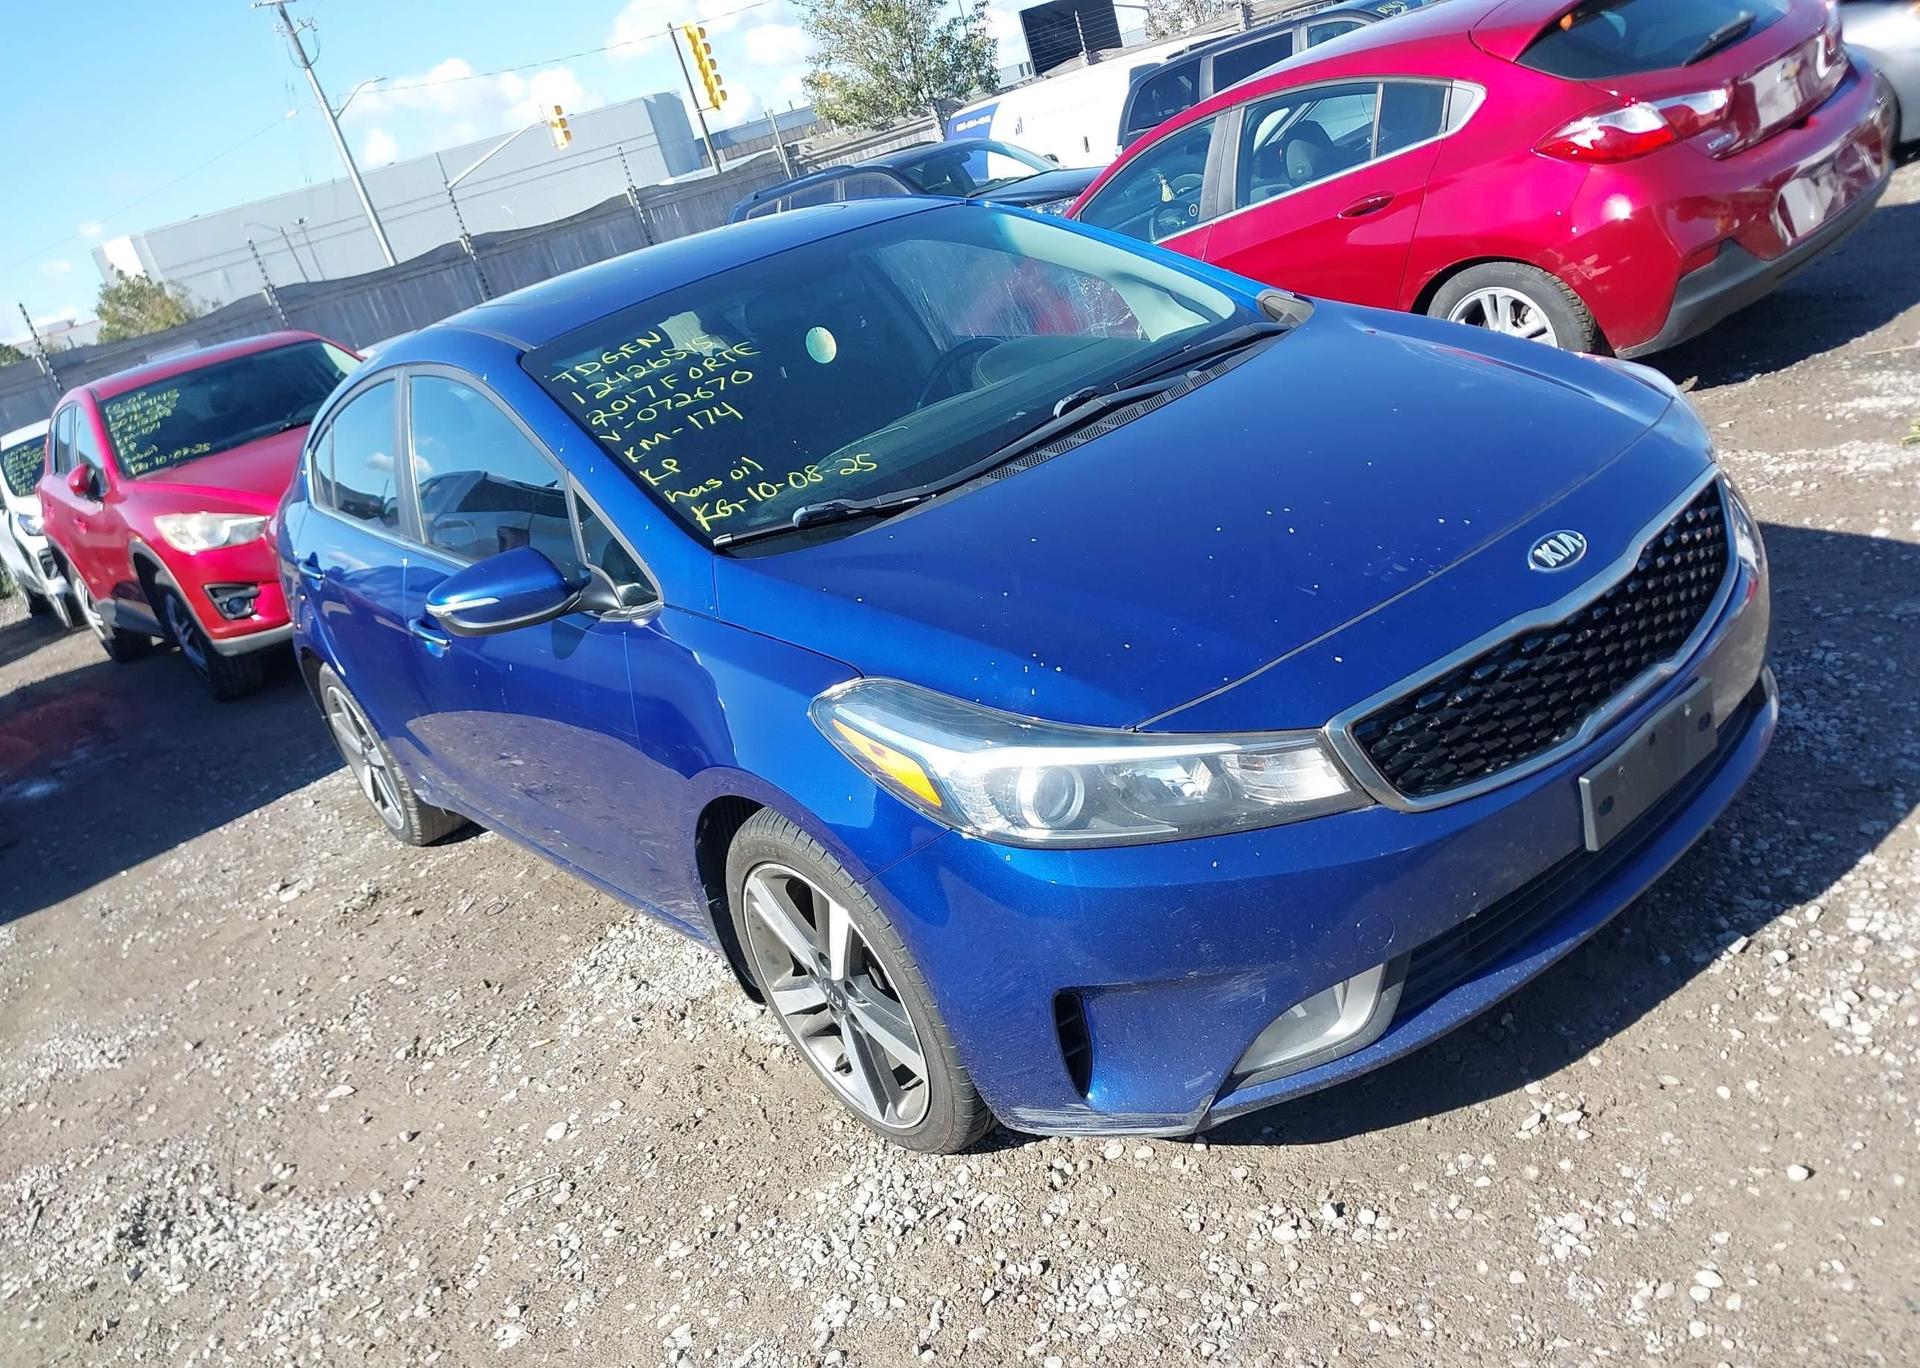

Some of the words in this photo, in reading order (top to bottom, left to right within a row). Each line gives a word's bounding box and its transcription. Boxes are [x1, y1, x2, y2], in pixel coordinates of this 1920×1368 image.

[571, 334, 713, 404] 12426515
[586, 385, 656, 427] 2017
[624, 401, 744, 463] KM-174
[640, 458, 681, 486] KP
[664, 478, 723, 503] has
[729, 456, 764, 481] oil
[1533, 533, 1583, 567] KIA
